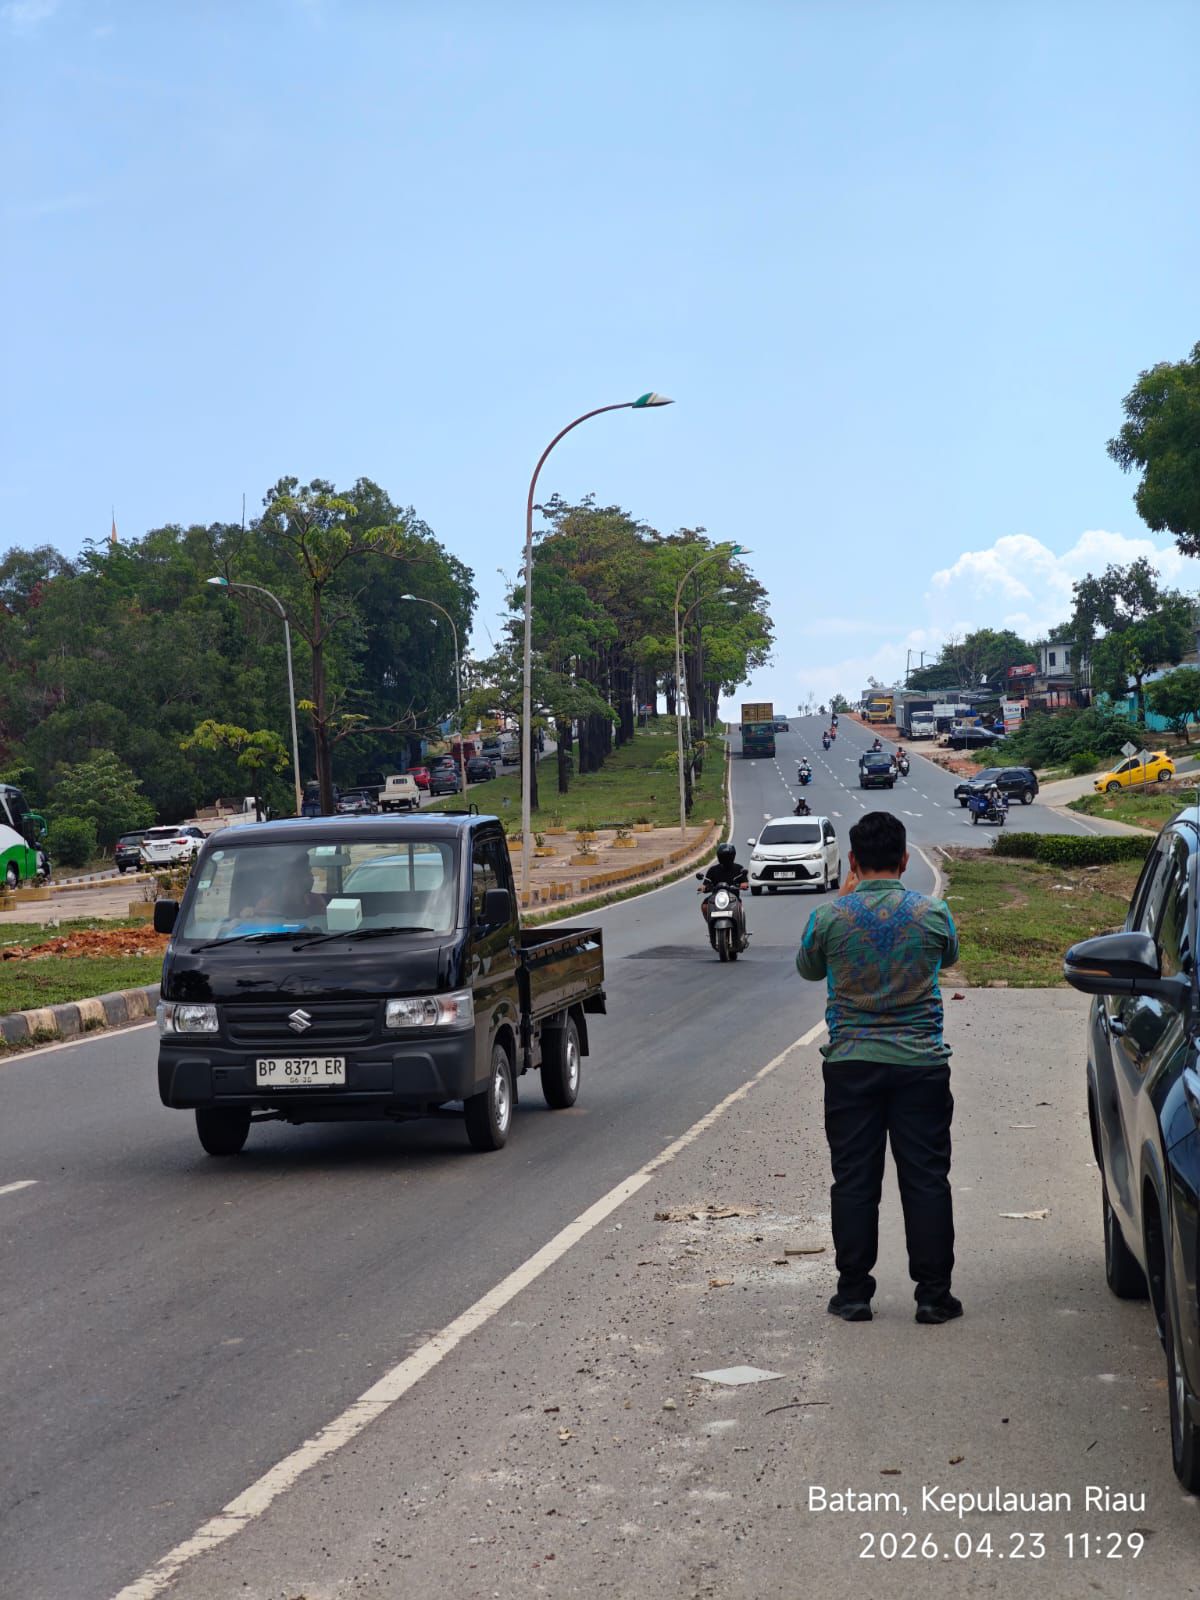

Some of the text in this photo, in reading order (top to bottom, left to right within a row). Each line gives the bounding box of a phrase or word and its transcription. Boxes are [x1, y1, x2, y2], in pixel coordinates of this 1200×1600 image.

[259, 1059, 342, 1076] BP 8371 ER
